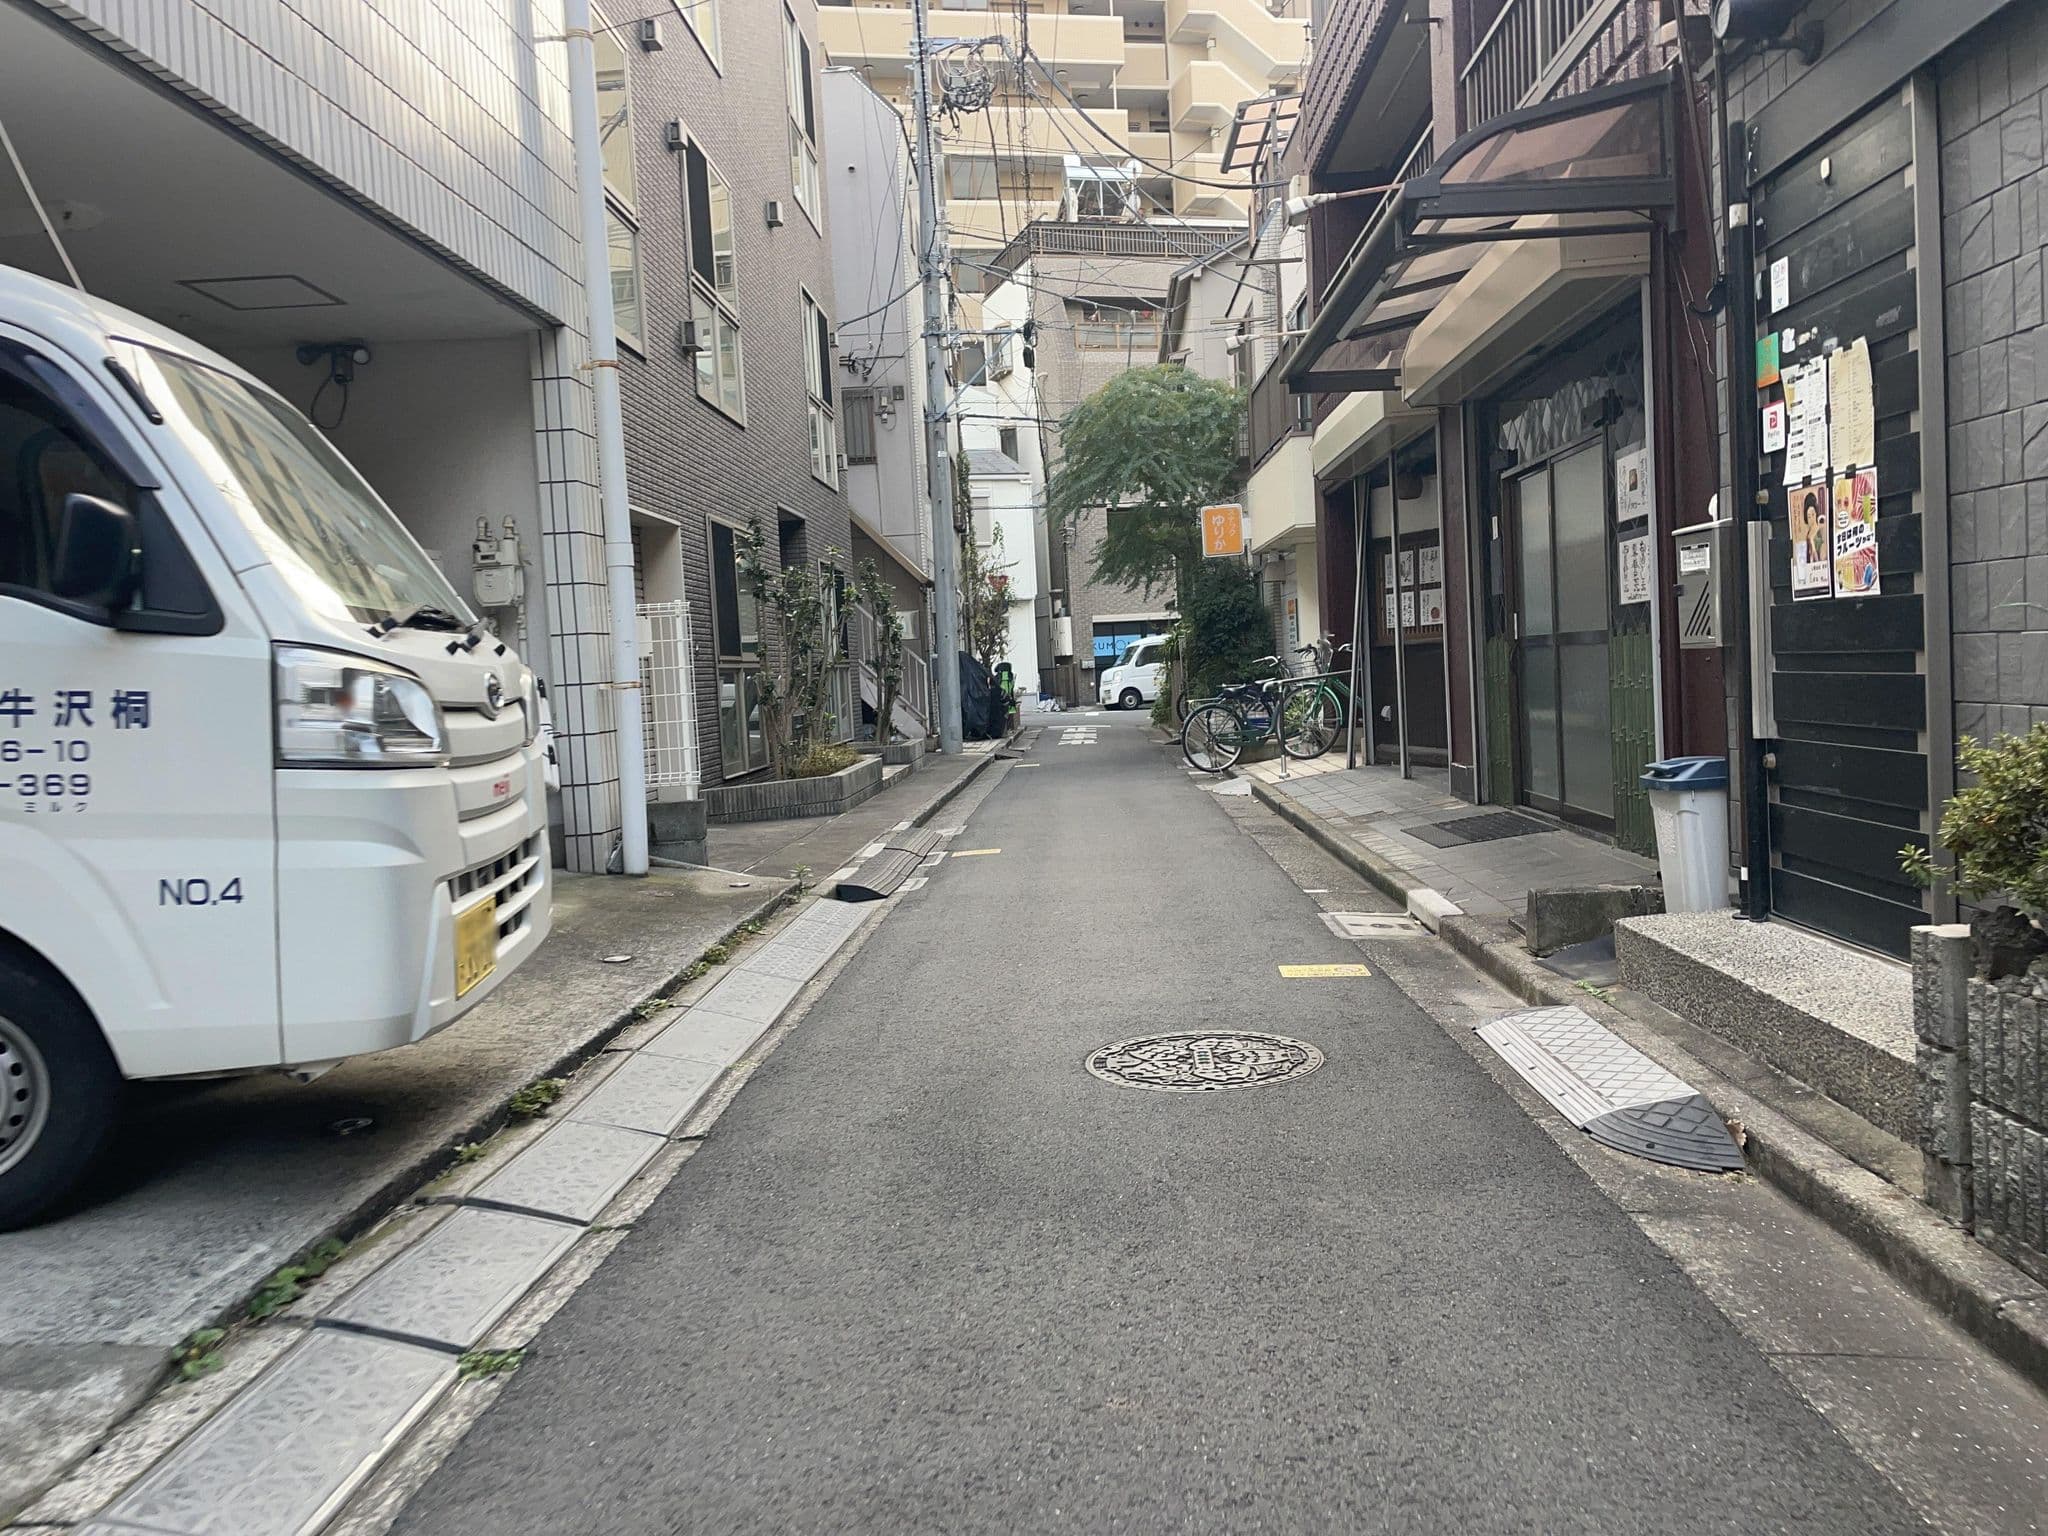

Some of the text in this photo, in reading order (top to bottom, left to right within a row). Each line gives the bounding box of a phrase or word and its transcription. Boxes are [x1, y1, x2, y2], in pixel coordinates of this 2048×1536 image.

[24, 801, 88, 813] ミルク
[159, 877, 243, 905] NO.4
